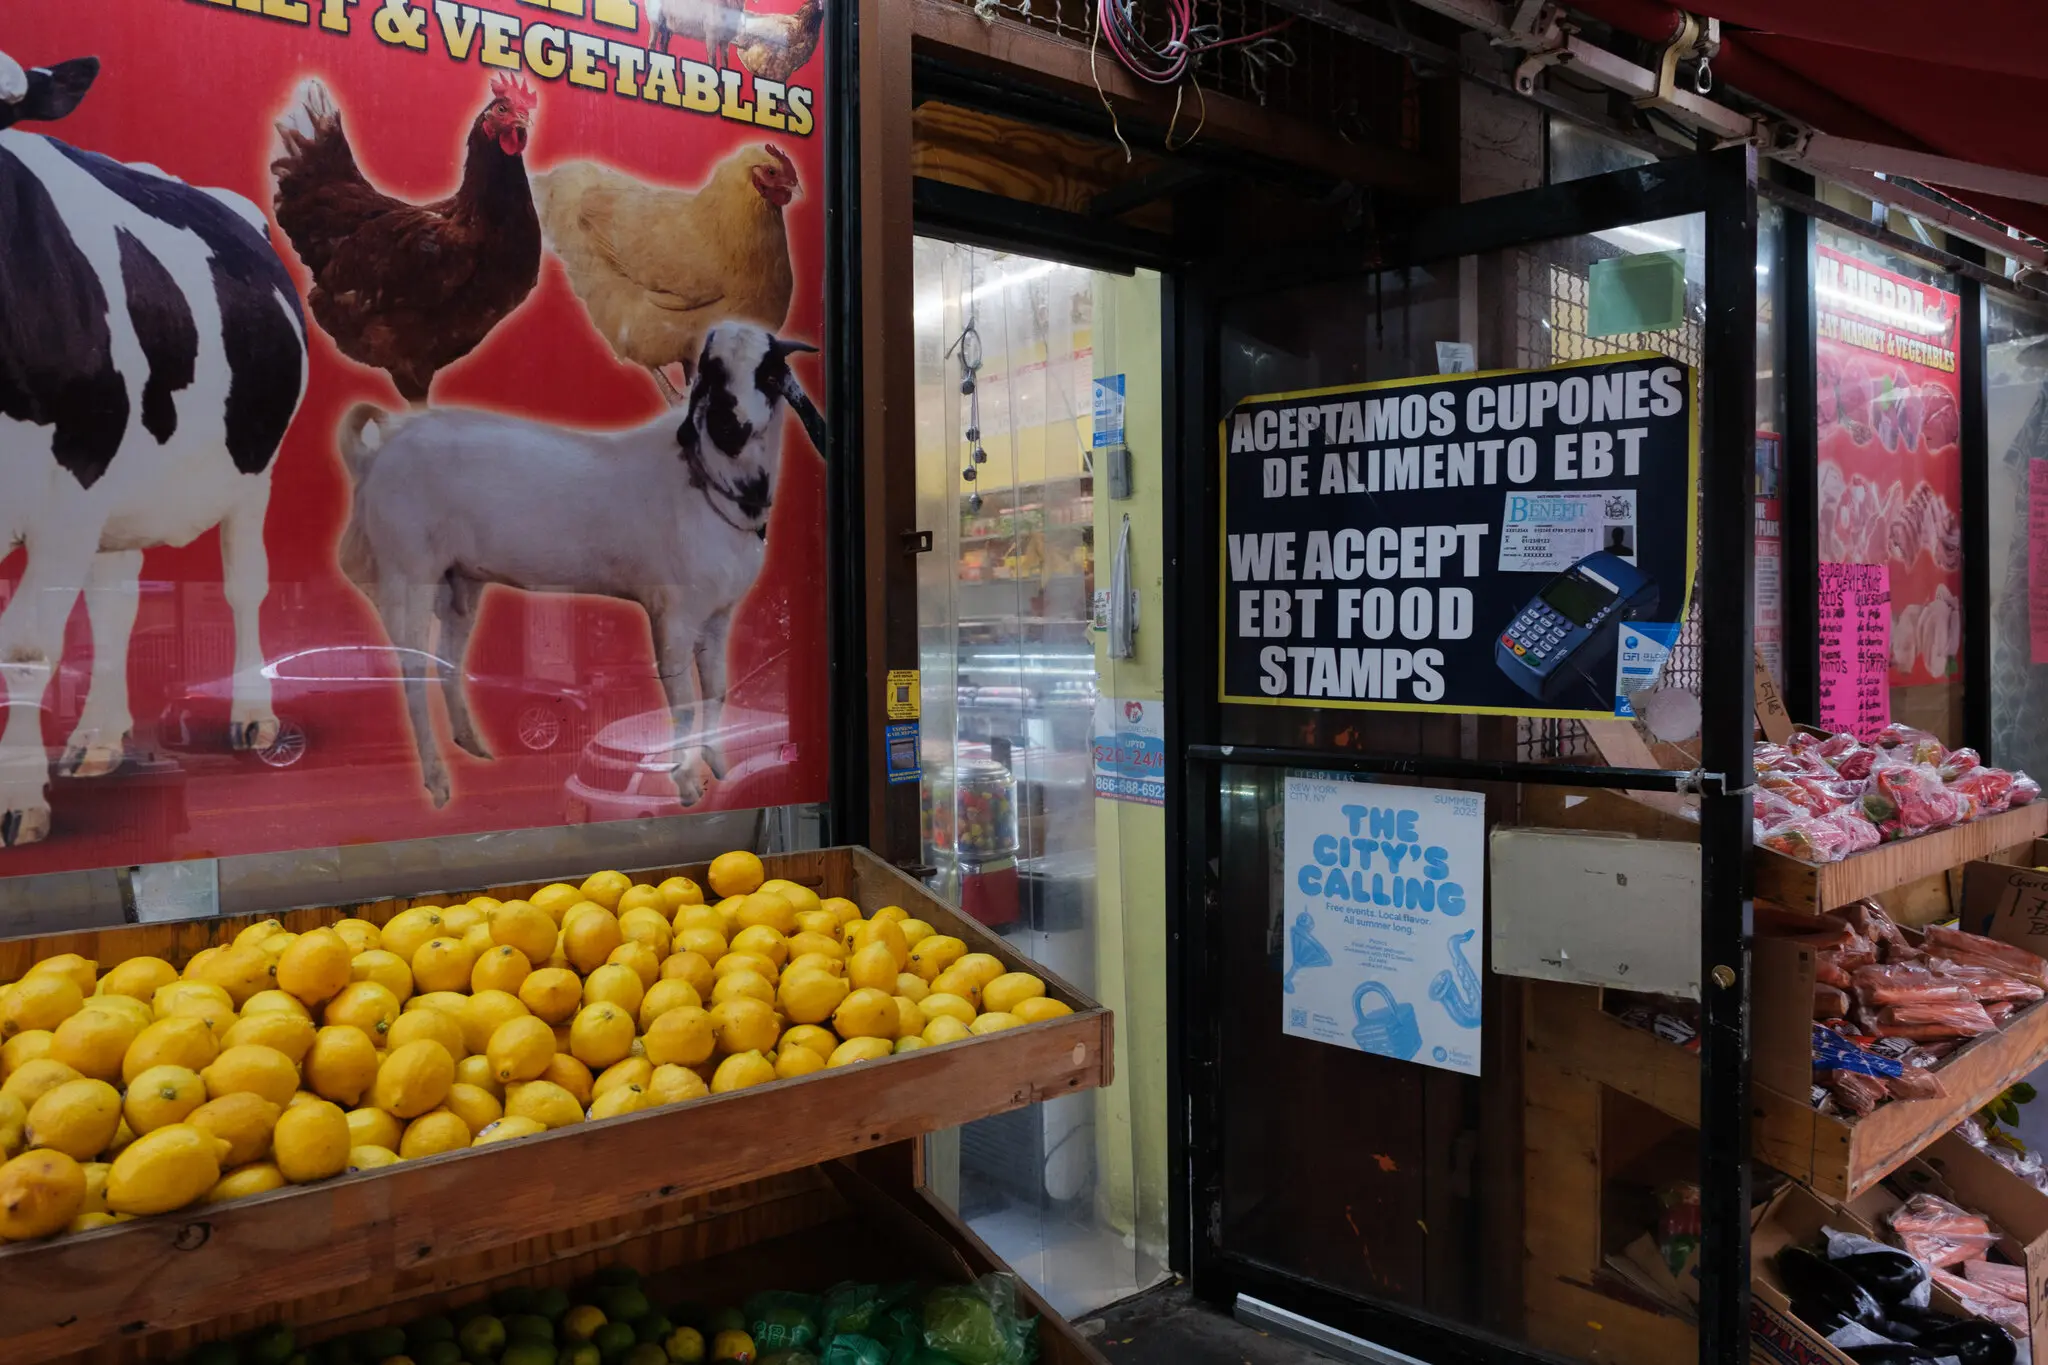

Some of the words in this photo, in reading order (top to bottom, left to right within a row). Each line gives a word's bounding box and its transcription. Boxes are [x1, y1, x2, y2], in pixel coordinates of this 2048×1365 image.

[434, 0, 815, 137] VEGETABLES
[1840, 317, 1886, 354] MARKET
[1895, 334, 1956, 374] VEGETABLES
[1230, 391, 1456, 454] ACEPTAMOS
[1466, 366, 1683, 433] CUPONES
[1263, 454, 1309, 499] DE
[1319, 436, 1538, 495] ALIMENTO
[1553, 427, 1649, 481] EBT
[1510, 496, 1588, 523] BENEFIT
[1228, 532, 1297, 582] WE
[1302, 523, 1489, 580] ACCEPT
[1238, 588, 1323, 638] EBT
[1337, 586, 1474, 641] FOOD
[1259, 645, 1446, 702] STAMPS
[1290, 783, 1310, 792] NEW
[1312, 785, 1338, 794] YORK
[1434, 795, 1477, 807] SUMMER
[1453, 807, 1477, 817] 2025
[1341, 804, 1420, 842] THE
[1297, 864, 1467, 917] CALLING
[1326, 902, 1344, 913] Free
[1346, 906, 1377, 918] events.
[1379, 910, 1402, 921] Local
[1402, 914, 1432, 926] flavor.
[1343, 916, 1355, 925] All
[1356, 919, 1391, 930] summer
[1392, 923, 1415, 936] long.
